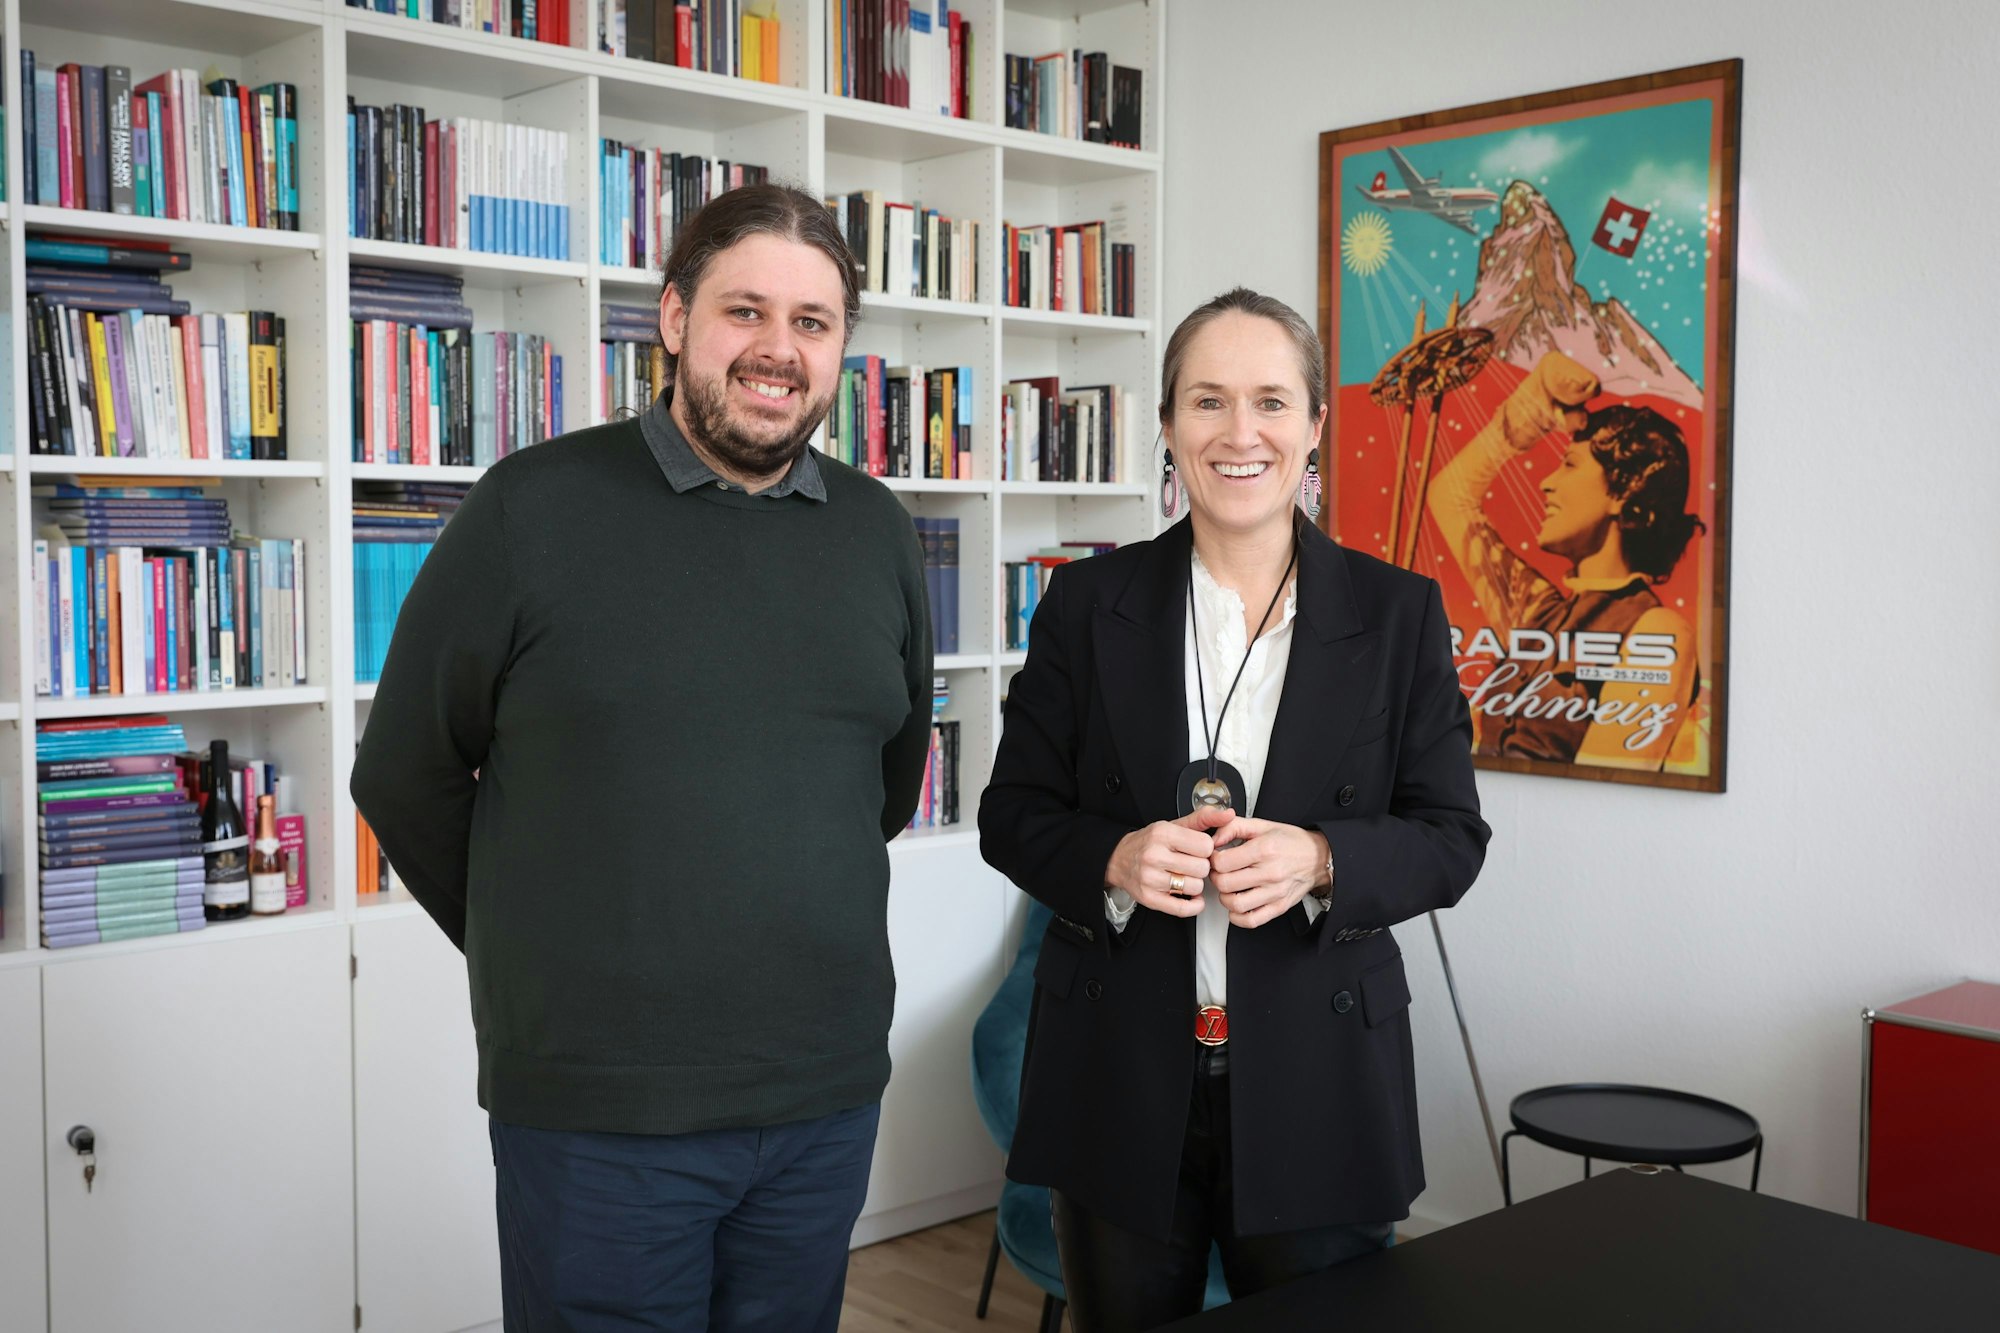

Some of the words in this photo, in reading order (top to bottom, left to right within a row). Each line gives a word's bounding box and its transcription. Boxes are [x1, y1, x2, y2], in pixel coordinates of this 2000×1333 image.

[111, 129, 122, 188] LANGUAGE
[120, 130, 131, 161] STYLE
[121, 163, 132, 188] AND
[41, 352, 51, 380] Patterns
[257, 350, 268, 382] Formal
[257, 384, 268, 429] Semantics
[1578, 668, 1604, 678] 17.3.
[1613, 669, 1668, 682] 25.7.2010
[1455, 660, 1678, 751] Schweiz
